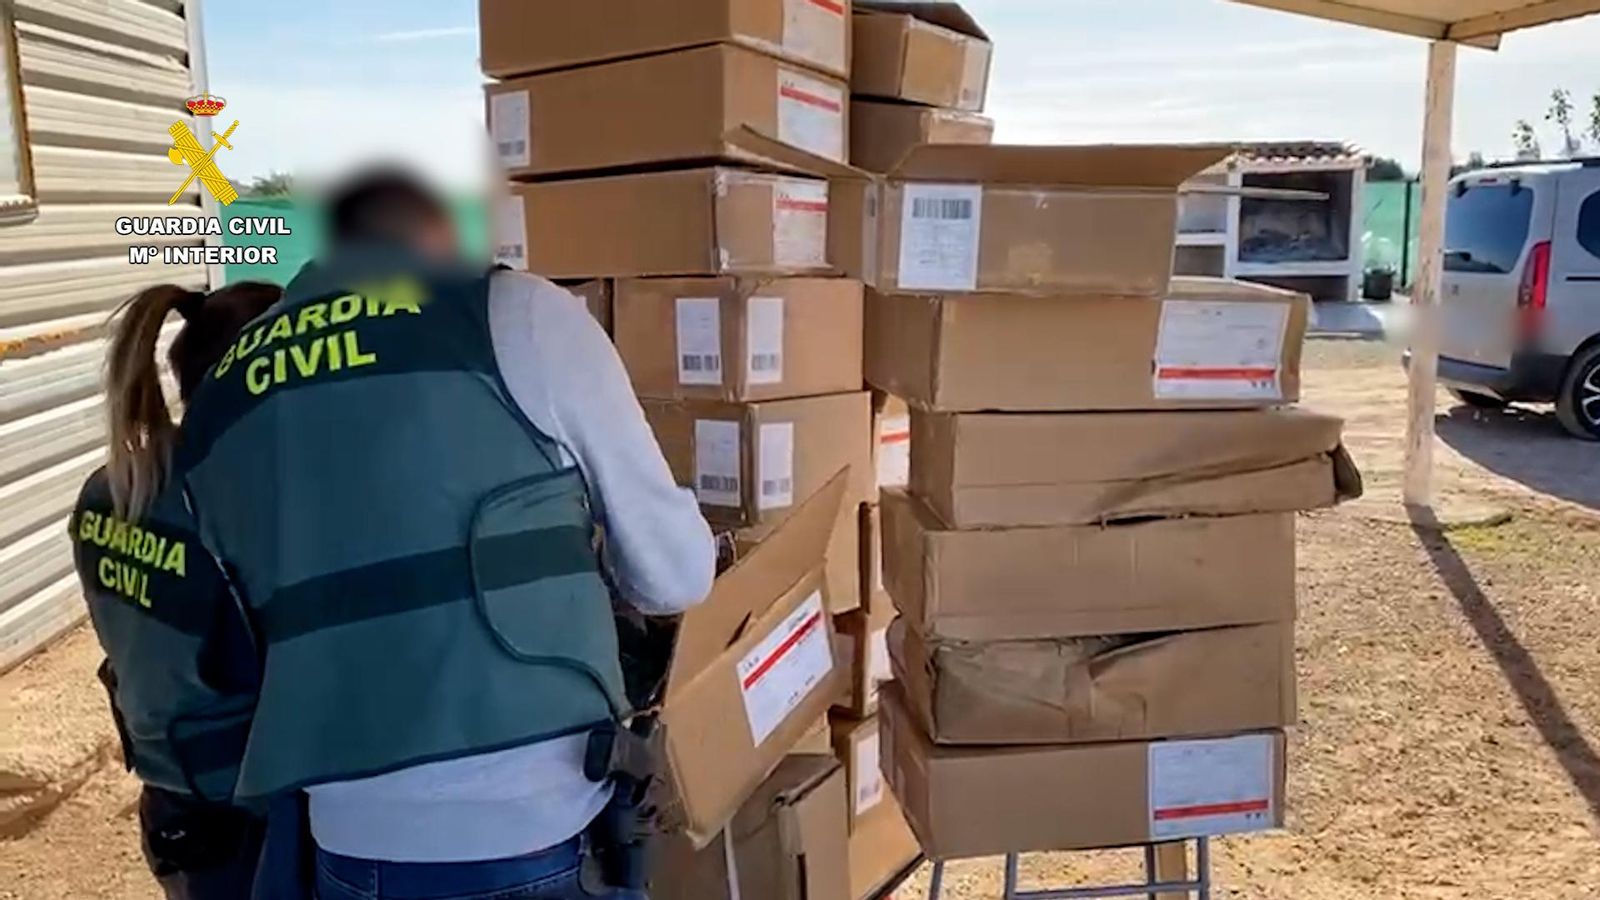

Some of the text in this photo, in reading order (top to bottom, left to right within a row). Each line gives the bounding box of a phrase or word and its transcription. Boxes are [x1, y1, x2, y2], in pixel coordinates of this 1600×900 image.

[245, 331, 376, 395] CIVIL
[79, 510, 186, 577] GUARDIA
[98, 557, 152, 608] CIVIL
